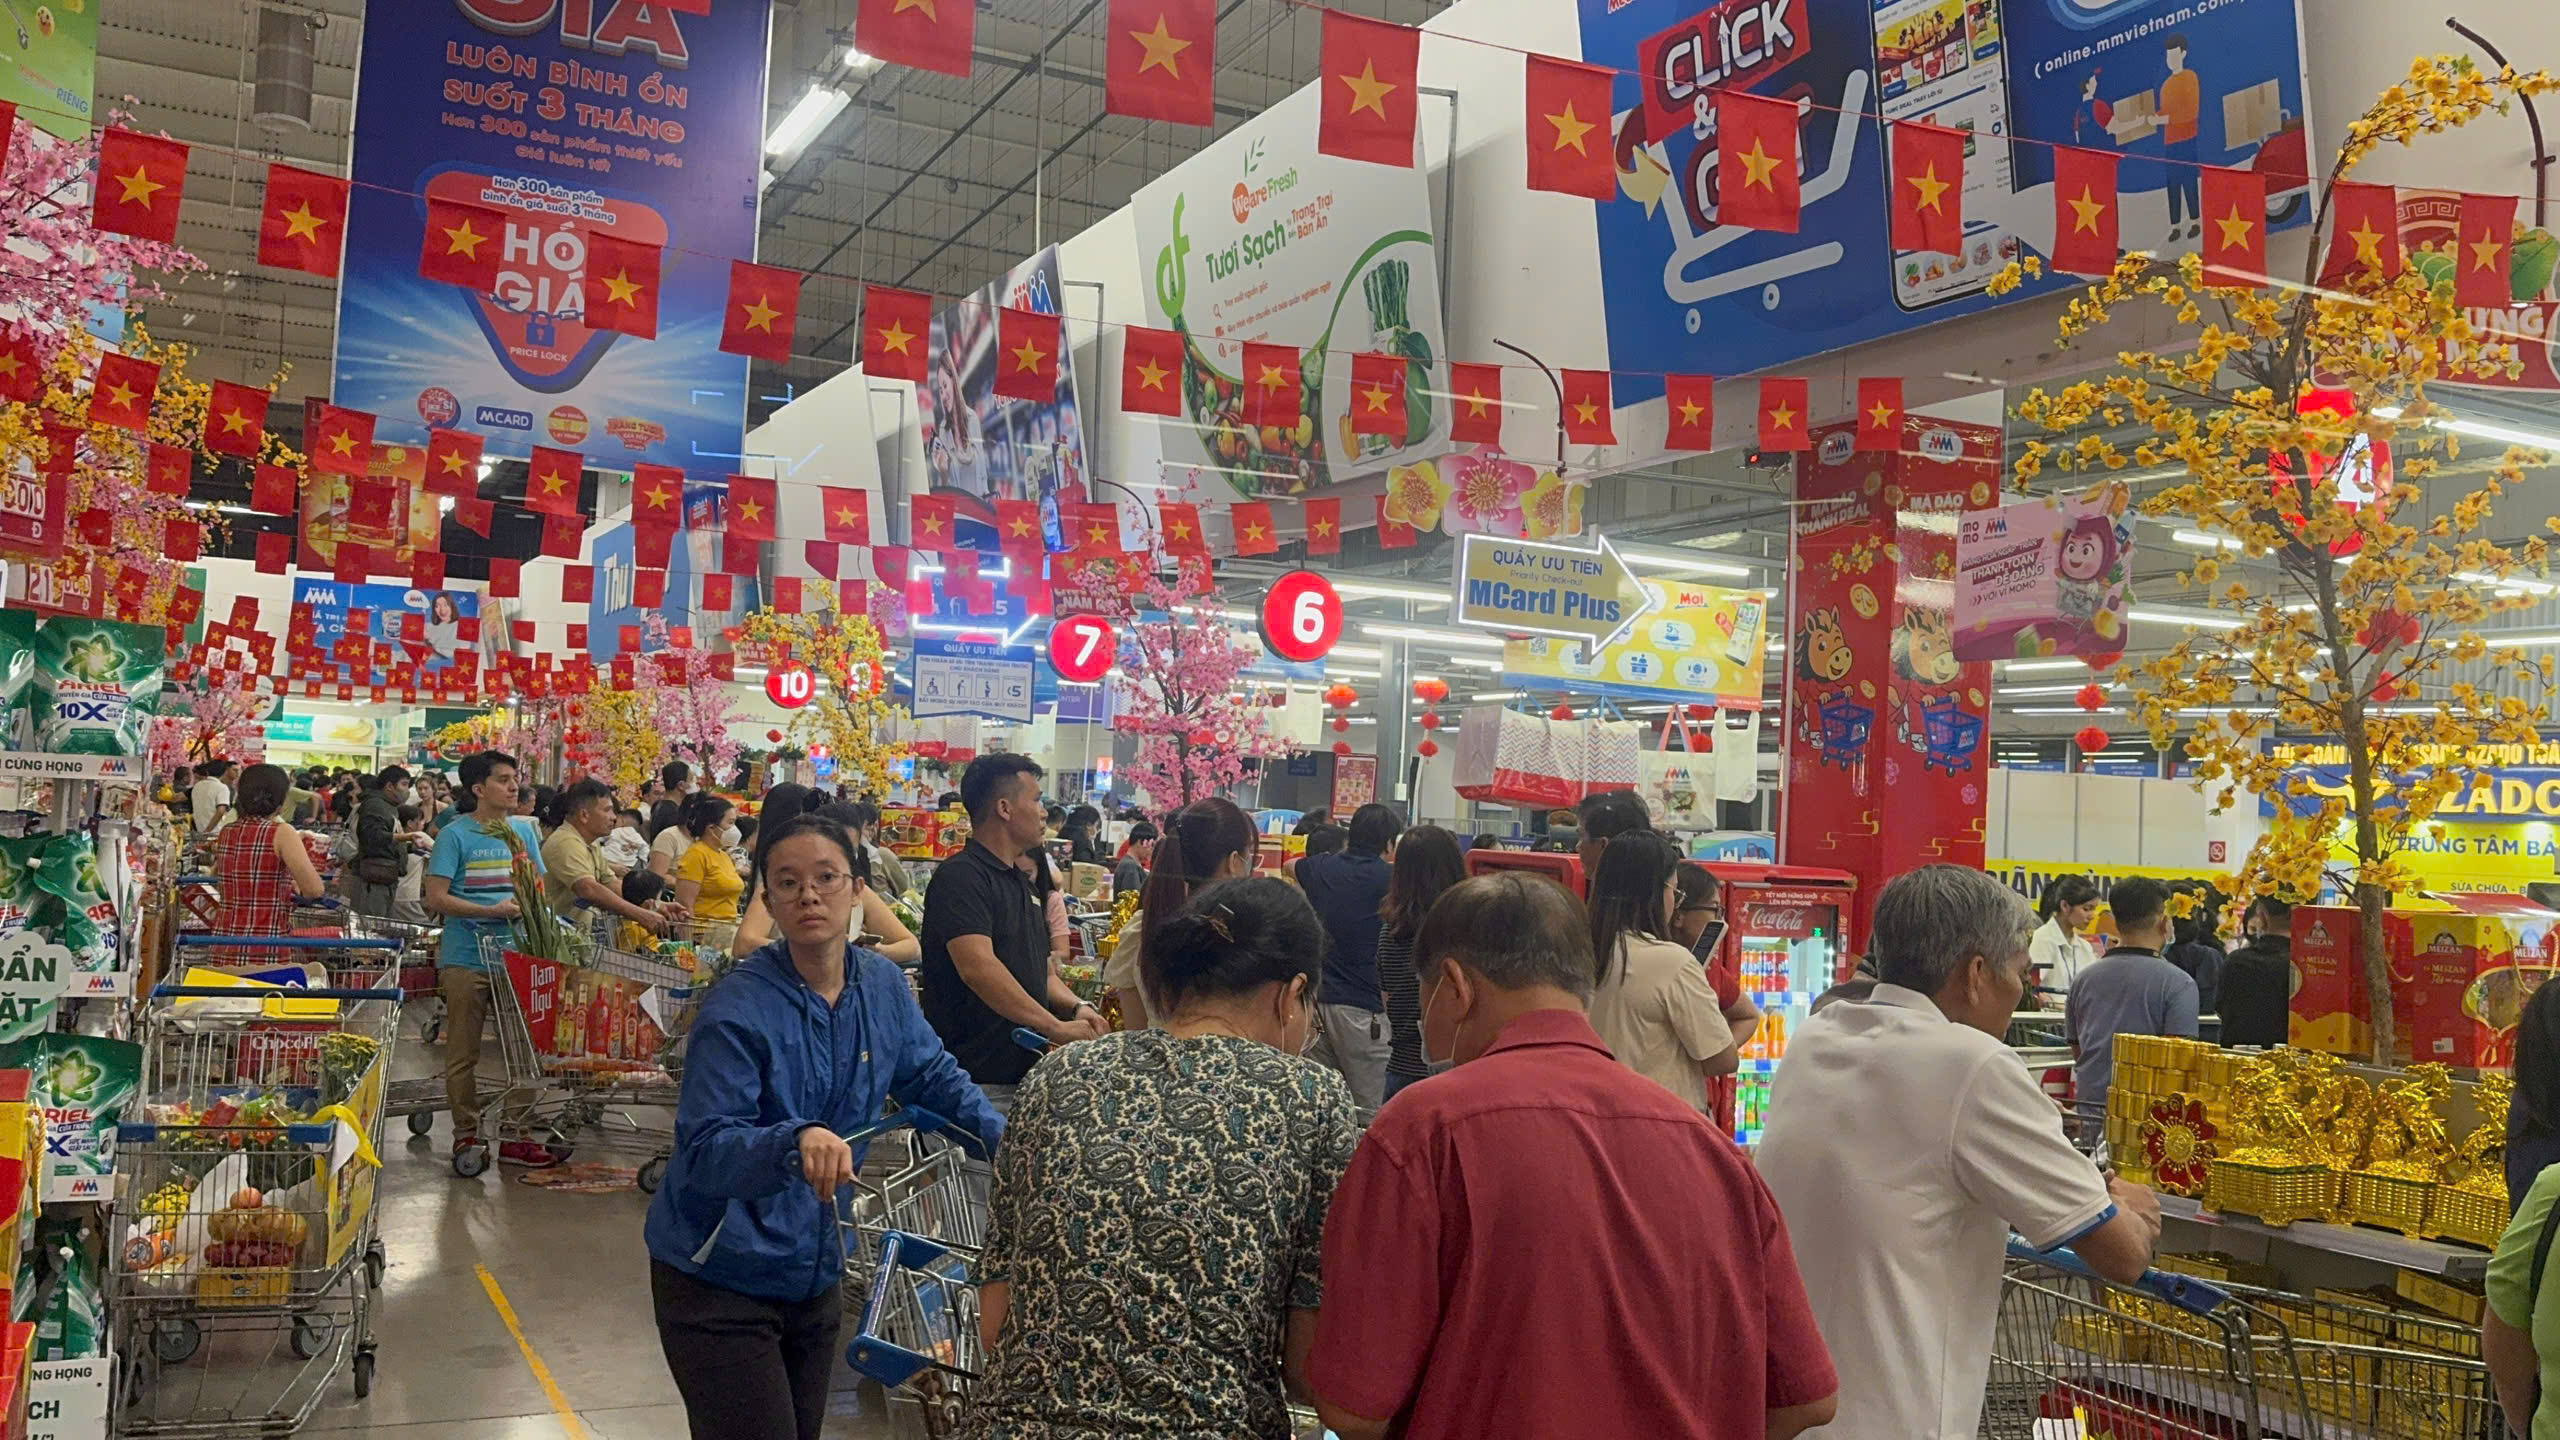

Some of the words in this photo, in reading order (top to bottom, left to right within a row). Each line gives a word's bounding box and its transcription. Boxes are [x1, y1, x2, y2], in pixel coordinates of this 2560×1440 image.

[1665, 0, 1795, 98] CLICK
[447, 41, 537, 79] LUÔN
[548, 59, 628, 97] BÌNH
[639, 71, 688, 109] ỔN
[443, 79, 528, 113] SUỐT
[536, 87, 566, 121] 3
[575, 103, 685, 144] THÁNG
[442, 112, 475, 129] Hơn
[479, 115, 527, 138] 300
[494, 176, 516, 190] Hơn
[519, 178, 548, 195] 300
[482, 190, 507, 204] bình
[526, 198, 544, 211] giá
[571, 203, 582, 216] 3
[583, 209, 616, 224] tháng
[1205, 240, 1240, 284] Tươi
[1242, 219, 1287, 269] Sạch
[510, 346, 539, 359] PRICE
[541, 350, 568, 362] LOCK
[1571, 558, 1603, 577] TIÊN
[1469, 578, 1557, 616] MCard
[1563, 591, 1621, 622] Plus
[1292, 591, 1325, 643] 6
[1074, 624, 1101, 667] 7
[779, 670, 809, 699] 10
[56, 701, 109, 722] 10X
[46, 761, 83, 776] HỌNG
[2474, 834, 2519, 856] TÂM
[2304, 937, 2335, 947] MEIZAN
[2429, 944, 2463, 955] MEIZAN
[2514, 947, 2549, 960] MEIZAN
[531, 963, 556, 989] Nam
[55, 1366, 93, 1382] HỌNG
